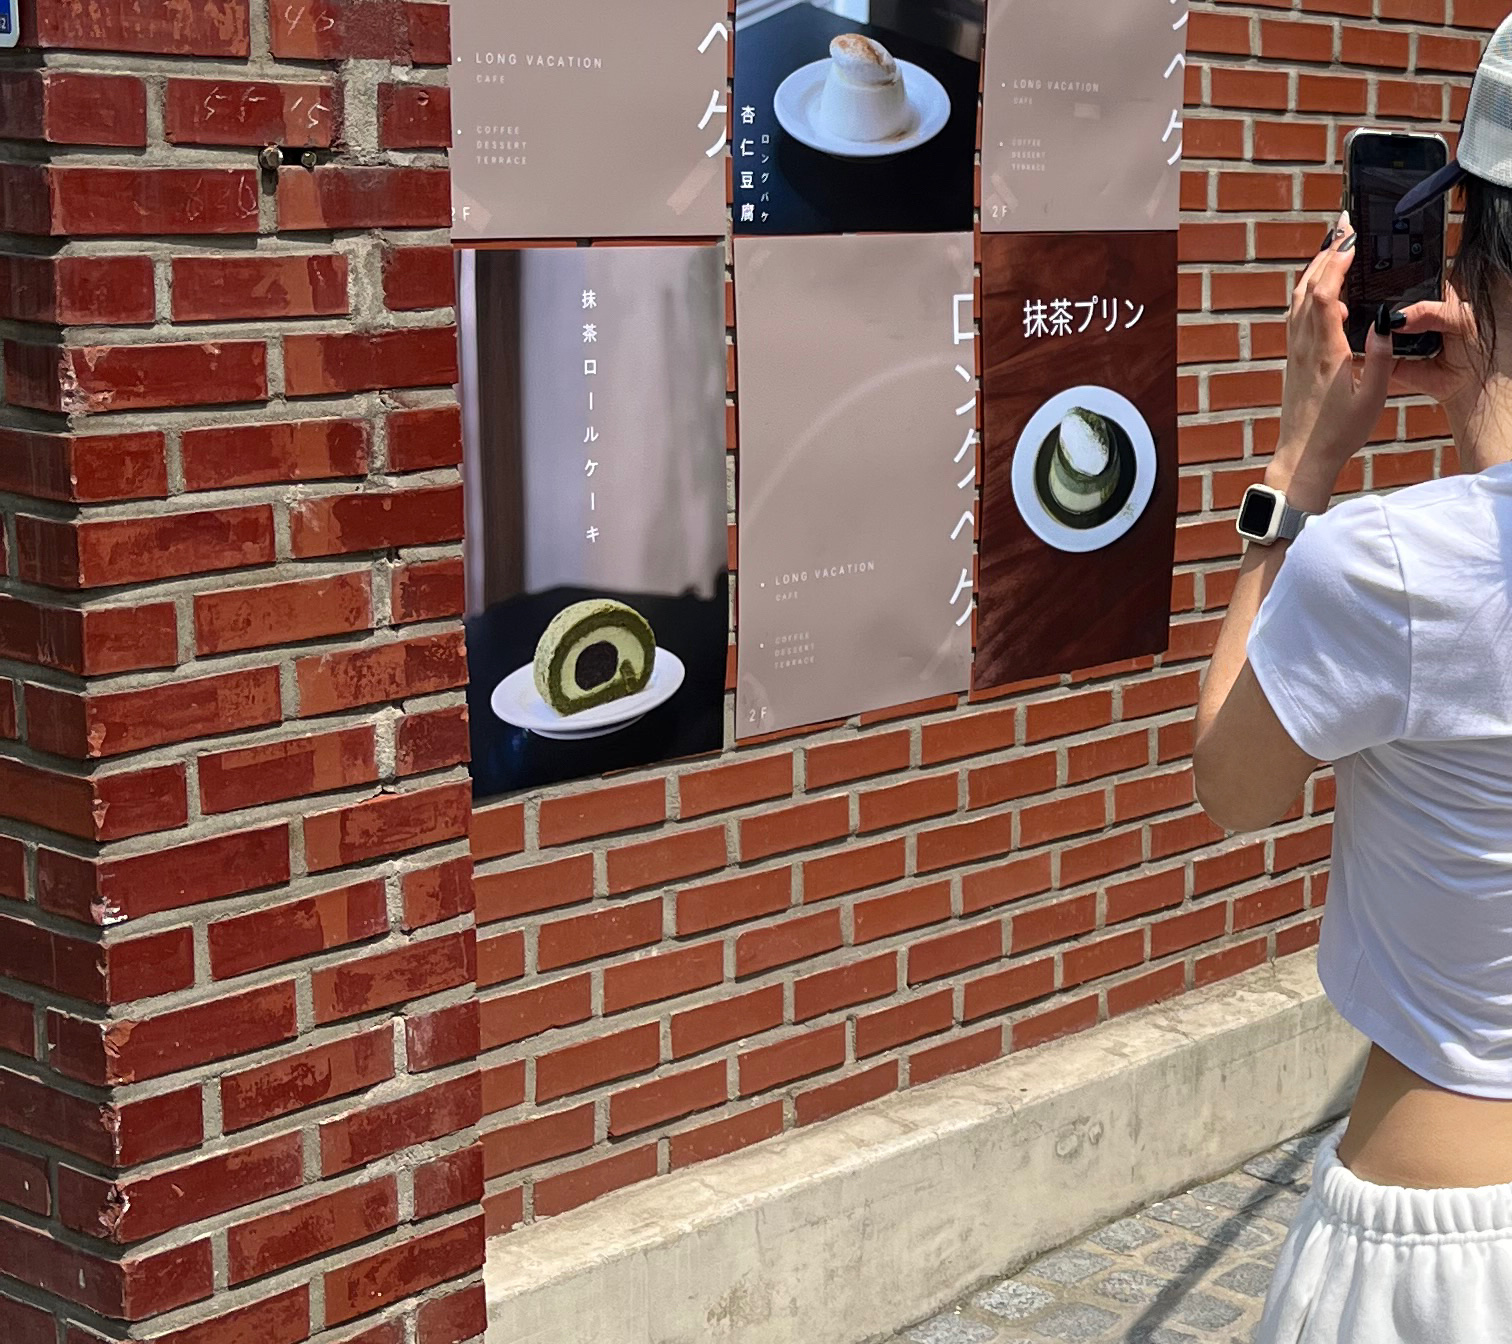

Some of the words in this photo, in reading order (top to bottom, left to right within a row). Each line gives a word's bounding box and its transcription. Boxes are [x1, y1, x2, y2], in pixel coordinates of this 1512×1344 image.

[475, 52, 517, 65] LONG
[526, 54, 602, 69] VACATION
[476, 74, 505, 84] CAFE
[1013, 80, 1042, 90] LONG
[1047, 81, 1099, 93] VACATION
[476, 126, 519, 135] COFFEE
[476, 140, 527, 150] DESSERT
[476, 156, 527, 165] TERRACE
[740, 105, 756, 222] 杏仁豆腐
[992, 205, 1008, 218] 2F
[1023, 294, 1145, 339] 抹茶プリン
[581, 288, 602, 544] 抹茶ロールケーキ
[775, 571, 808, 586] LONG
[815, 560, 875, 579] VACATION
[775, 587, 799, 602] CAFE
[749, 706, 767, 722] 2F
